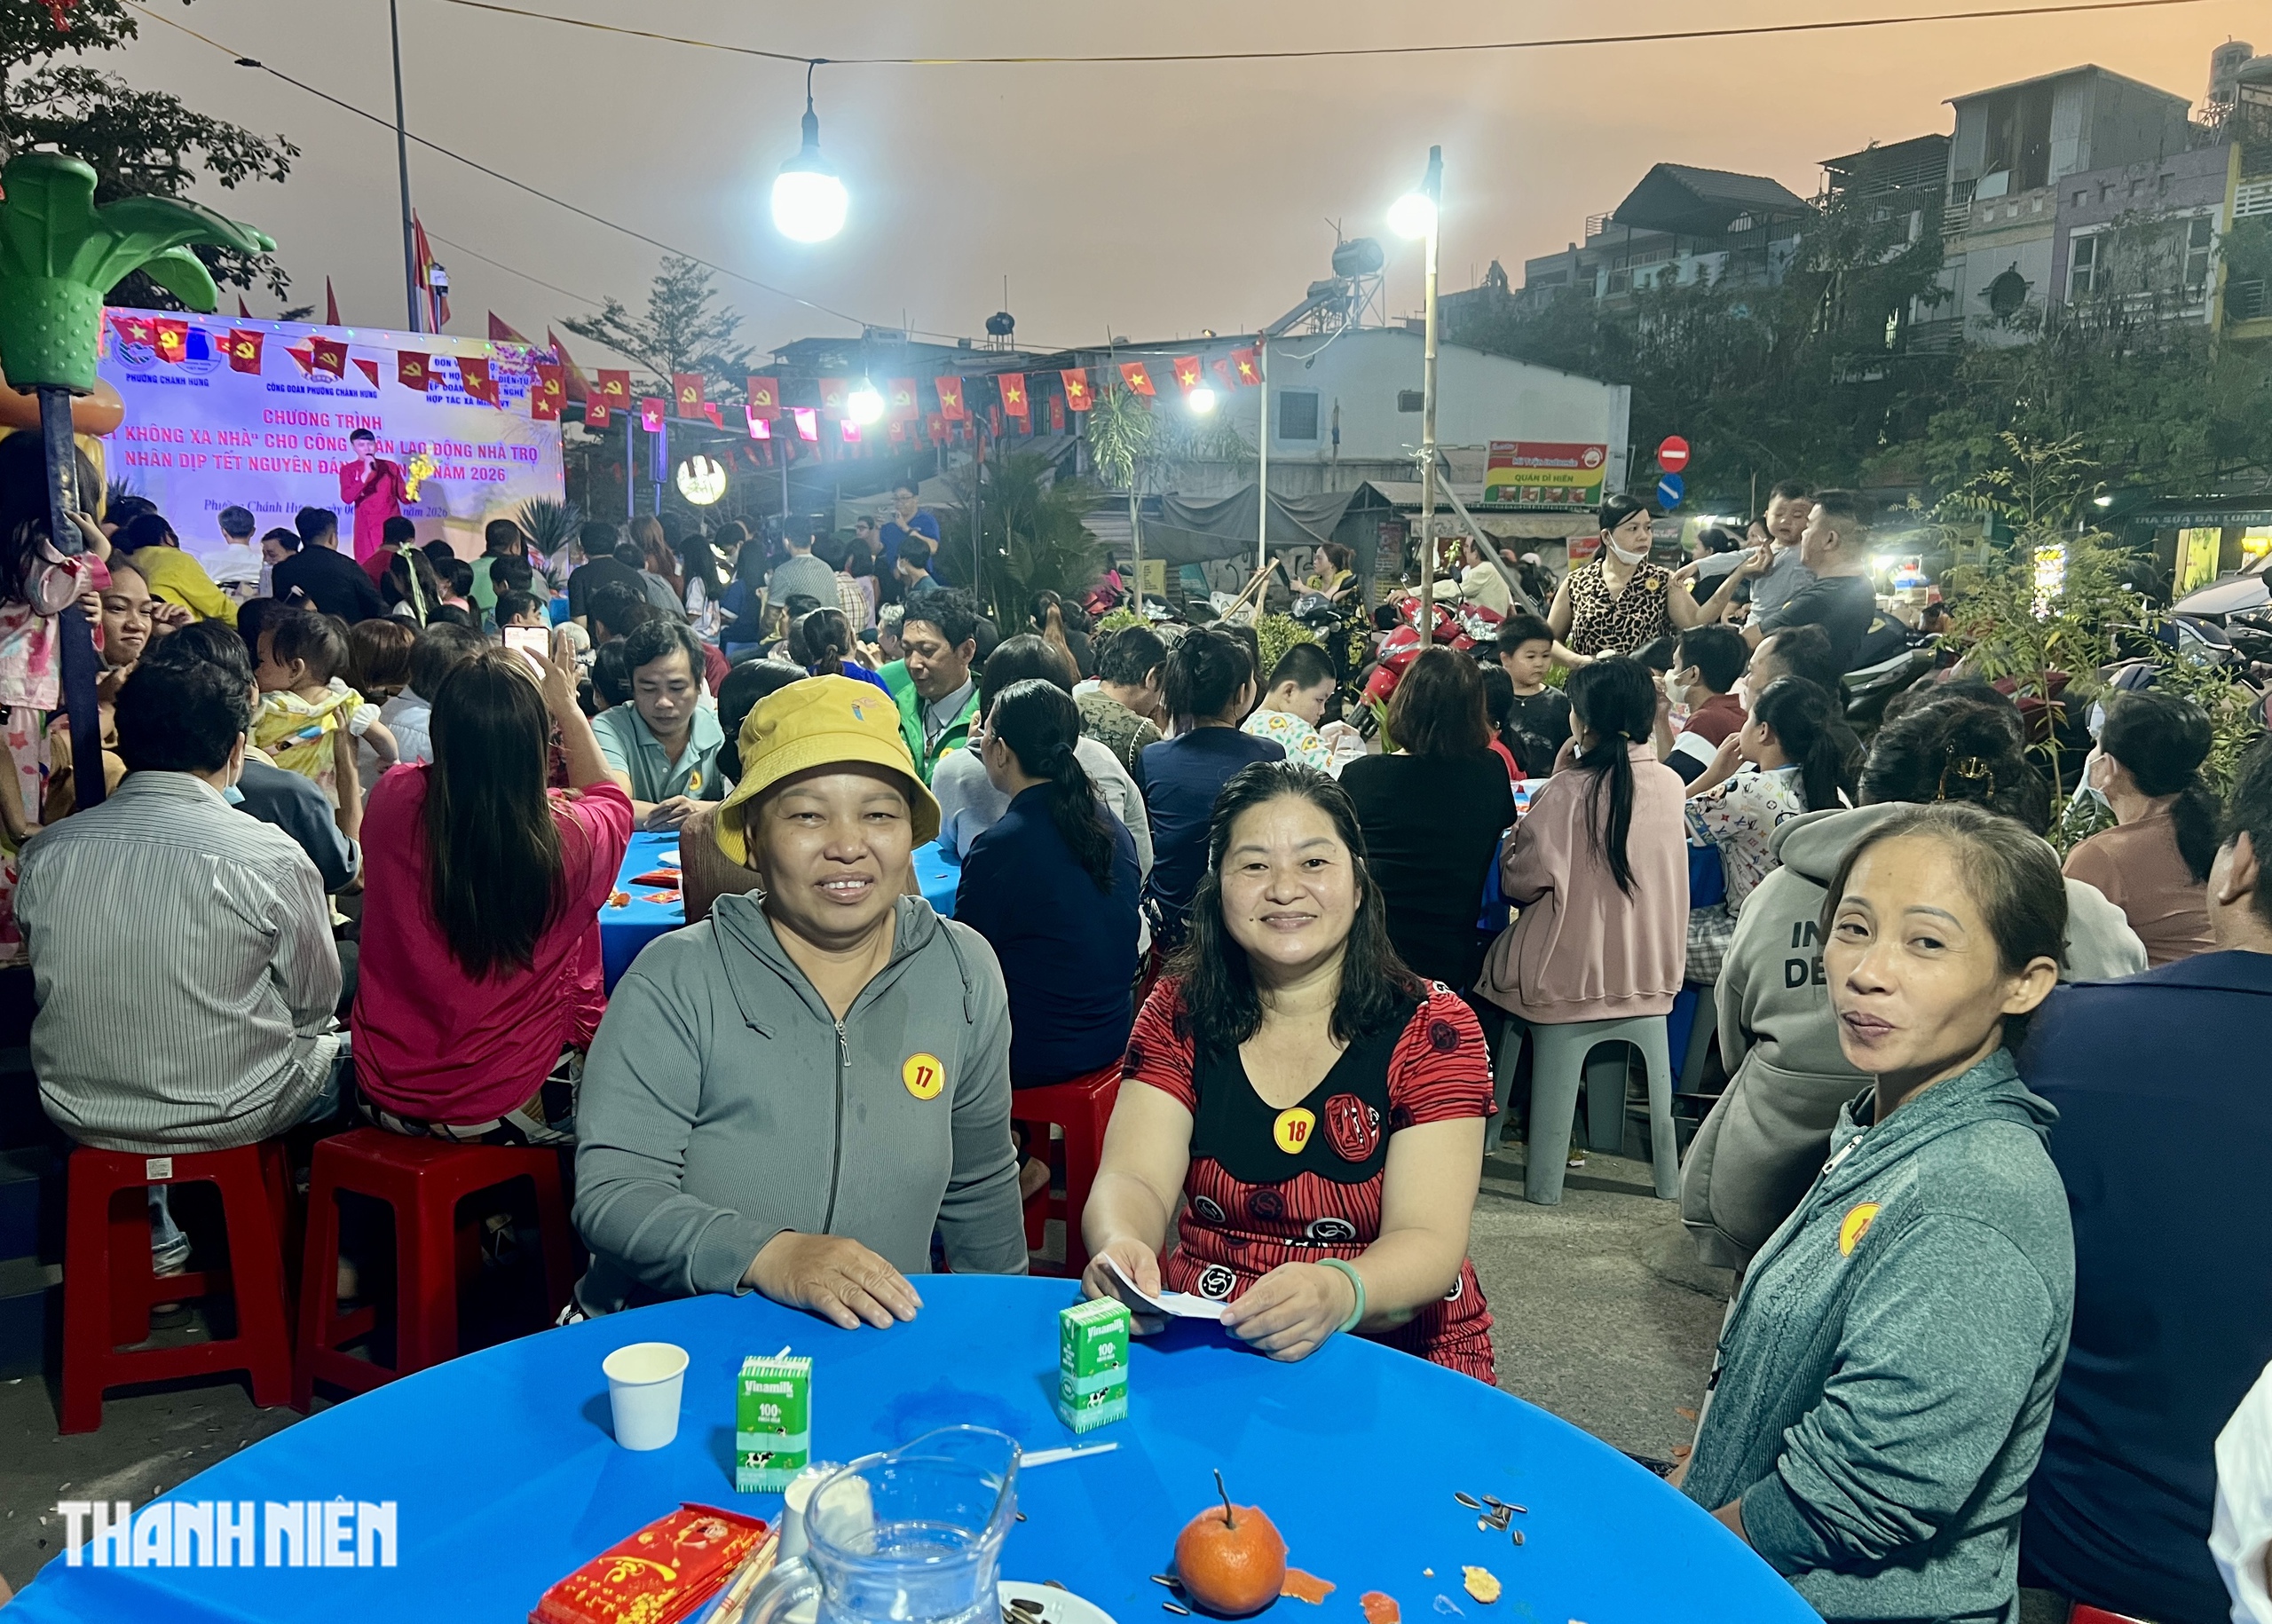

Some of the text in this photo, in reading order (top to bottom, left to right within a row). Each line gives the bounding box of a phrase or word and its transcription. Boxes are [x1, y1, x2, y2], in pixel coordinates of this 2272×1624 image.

[262, 408, 383, 430] CHƯƠNG TRÌNH
[124, 422, 185, 444] KHÔNG
[189, 429, 212, 445] XA
[264, 432, 298, 450] CHO
[304, 431, 347, 453] CÔNG
[432, 438, 472, 460] ĐỘNG
[477, 441, 507, 461] NHÀ
[510, 445, 538, 462] TRỌ
[124, 448, 172, 468] NHÂN
[178, 453, 208, 472] DỊP
[212, 449, 242, 470] TẾT
[248, 452, 312, 474] NGUYÊN
[433, 464, 464, 481] NĂM
[470, 467, 506, 482] 2026
[915, 1065, 934, 1089] 17
[1287, 1120, 1307, 1142] 18
[1087, 1318, 1124, 1344] Vinamilk
[745, 1380, 793, 1396] Vinamilk
